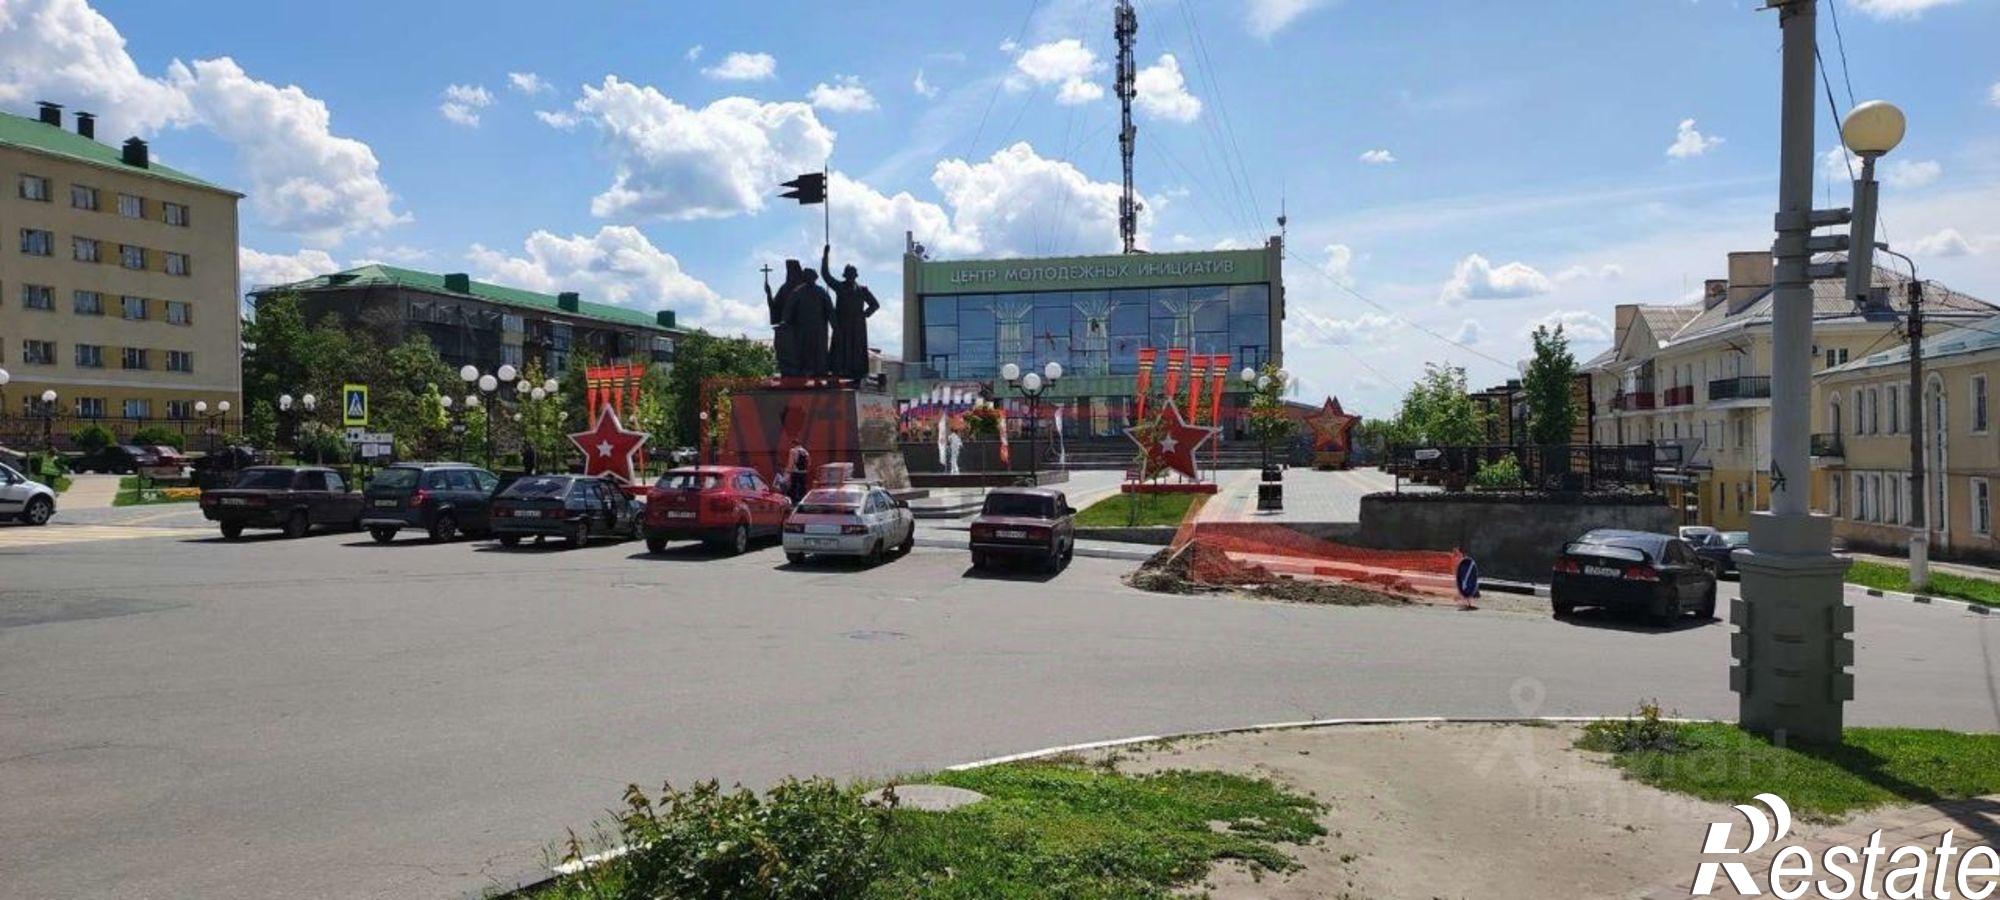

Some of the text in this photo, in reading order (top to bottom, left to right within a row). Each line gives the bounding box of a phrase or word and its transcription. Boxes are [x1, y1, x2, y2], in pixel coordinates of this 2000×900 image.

[951, 259, 1236, 284] ЦЕНТР МОЛОДЕЖНЫХ ИНИЦИАТИВ
